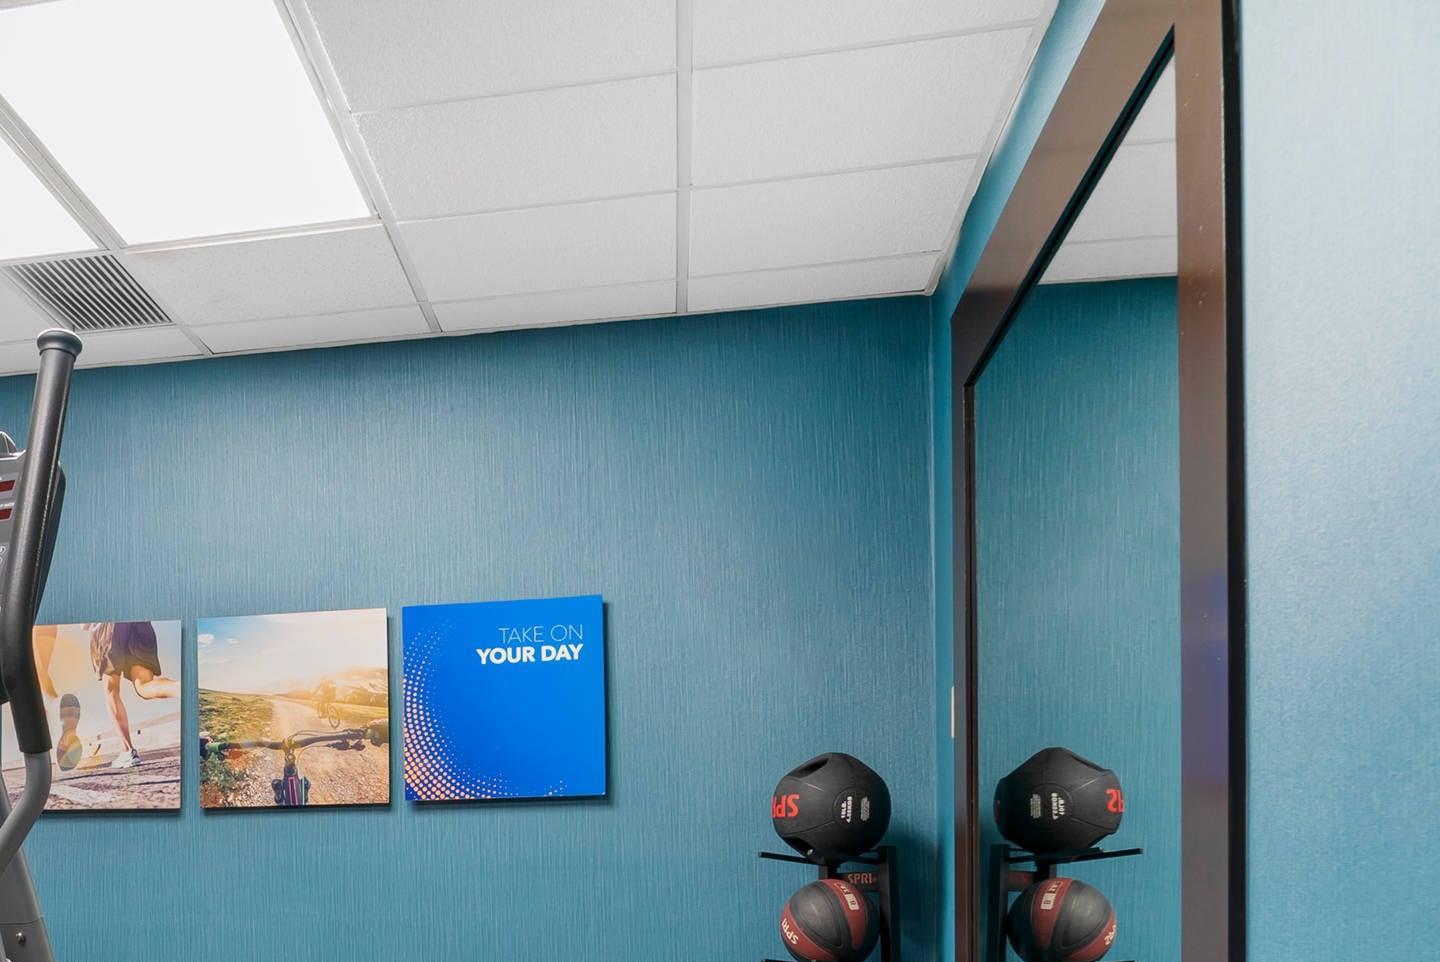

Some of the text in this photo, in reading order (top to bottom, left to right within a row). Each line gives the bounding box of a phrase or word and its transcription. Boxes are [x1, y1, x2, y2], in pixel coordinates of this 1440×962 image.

[498, 623, 583, 644] TAKE ON
[476, 643, 584, 665] YOUR DAY
